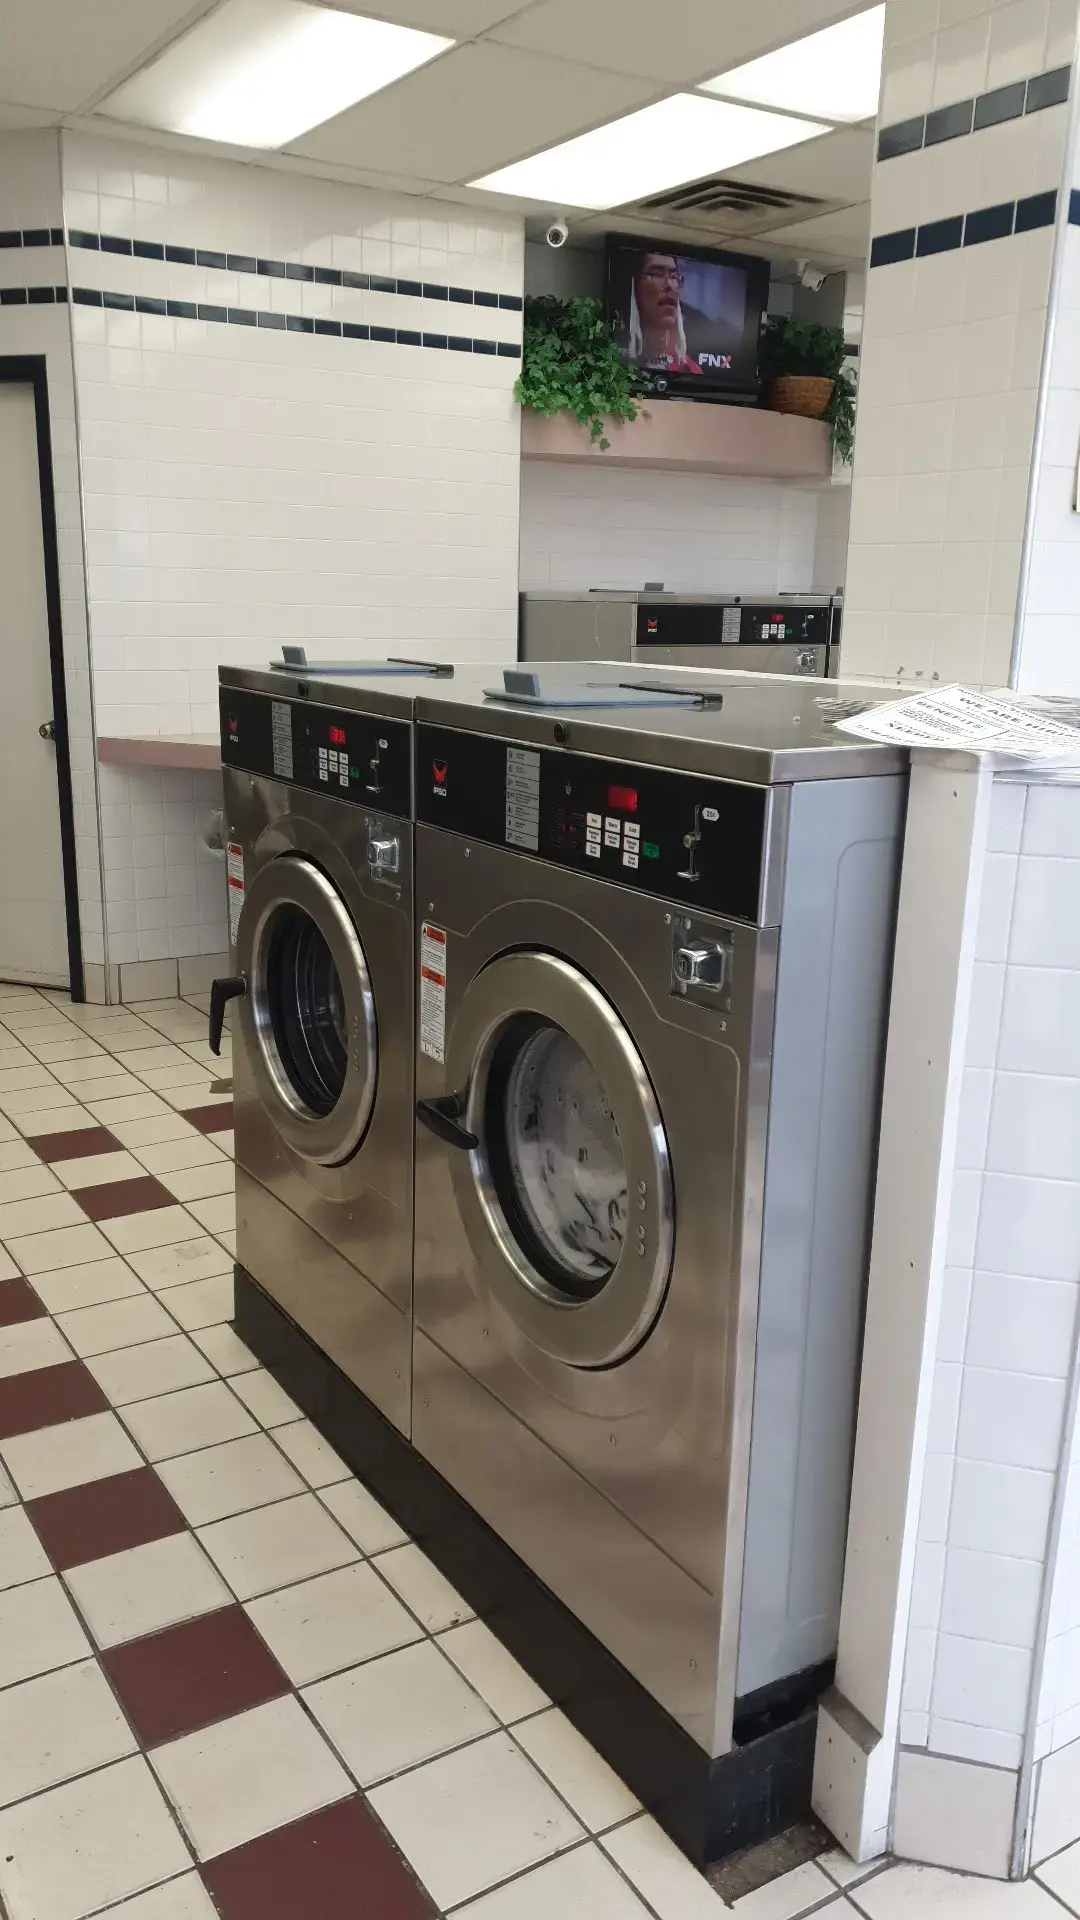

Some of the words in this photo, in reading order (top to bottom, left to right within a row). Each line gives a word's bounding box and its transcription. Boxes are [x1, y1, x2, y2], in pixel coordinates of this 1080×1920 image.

[698, 352, 732, 369] FNX
[960, 697, 986, 709] WE
[986, 709, 1024, 724] ARE
[1024, 723, 1079, 738] HIRIN
[433, 786, 447, 797] IPSO
